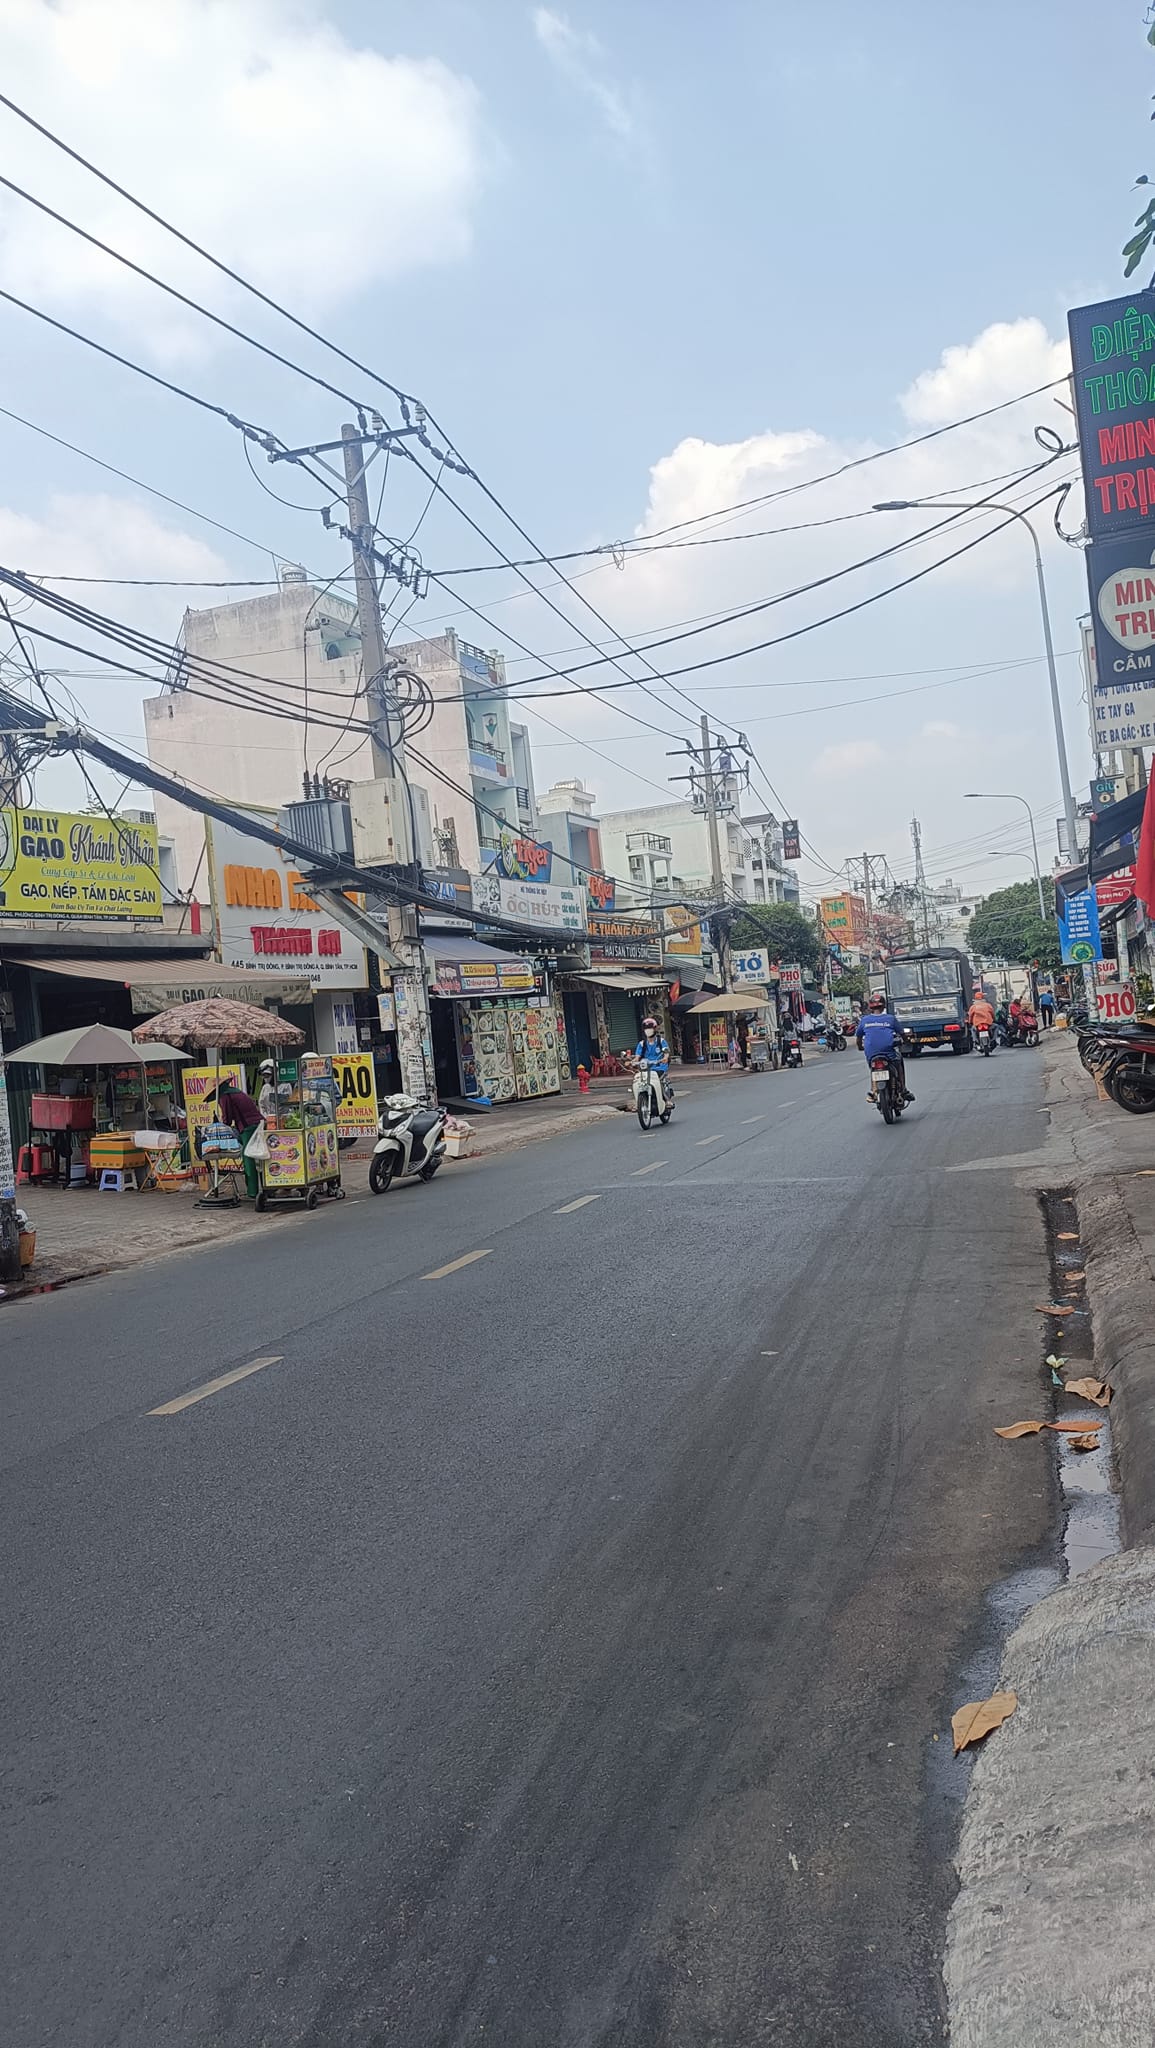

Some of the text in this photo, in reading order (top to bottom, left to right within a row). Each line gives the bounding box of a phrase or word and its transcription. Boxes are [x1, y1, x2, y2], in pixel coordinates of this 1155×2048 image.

[1113, 653, 1152, 673] CẦM
[1096, 702, 1136, 720] XE TAY GA
[1097, 730, 1108, 744] XE
[1110, 728, 1120, 743] BA
[23, 816, 58, 834] ĐẠI LÝ
[20, 836, 64, 862] GẠO
[70, 823, 116, 864] Khánh
[513, 838, 550, 876] Tiger
[82, 882, 106, 901] TẤM
[110, 888, 131, 904] ĐẶC
[507, 894, 560, 916] ỐC HÚT
[232, 960, 244, 969] 445
[1096, 984, 1134, 1018] PHỞ
